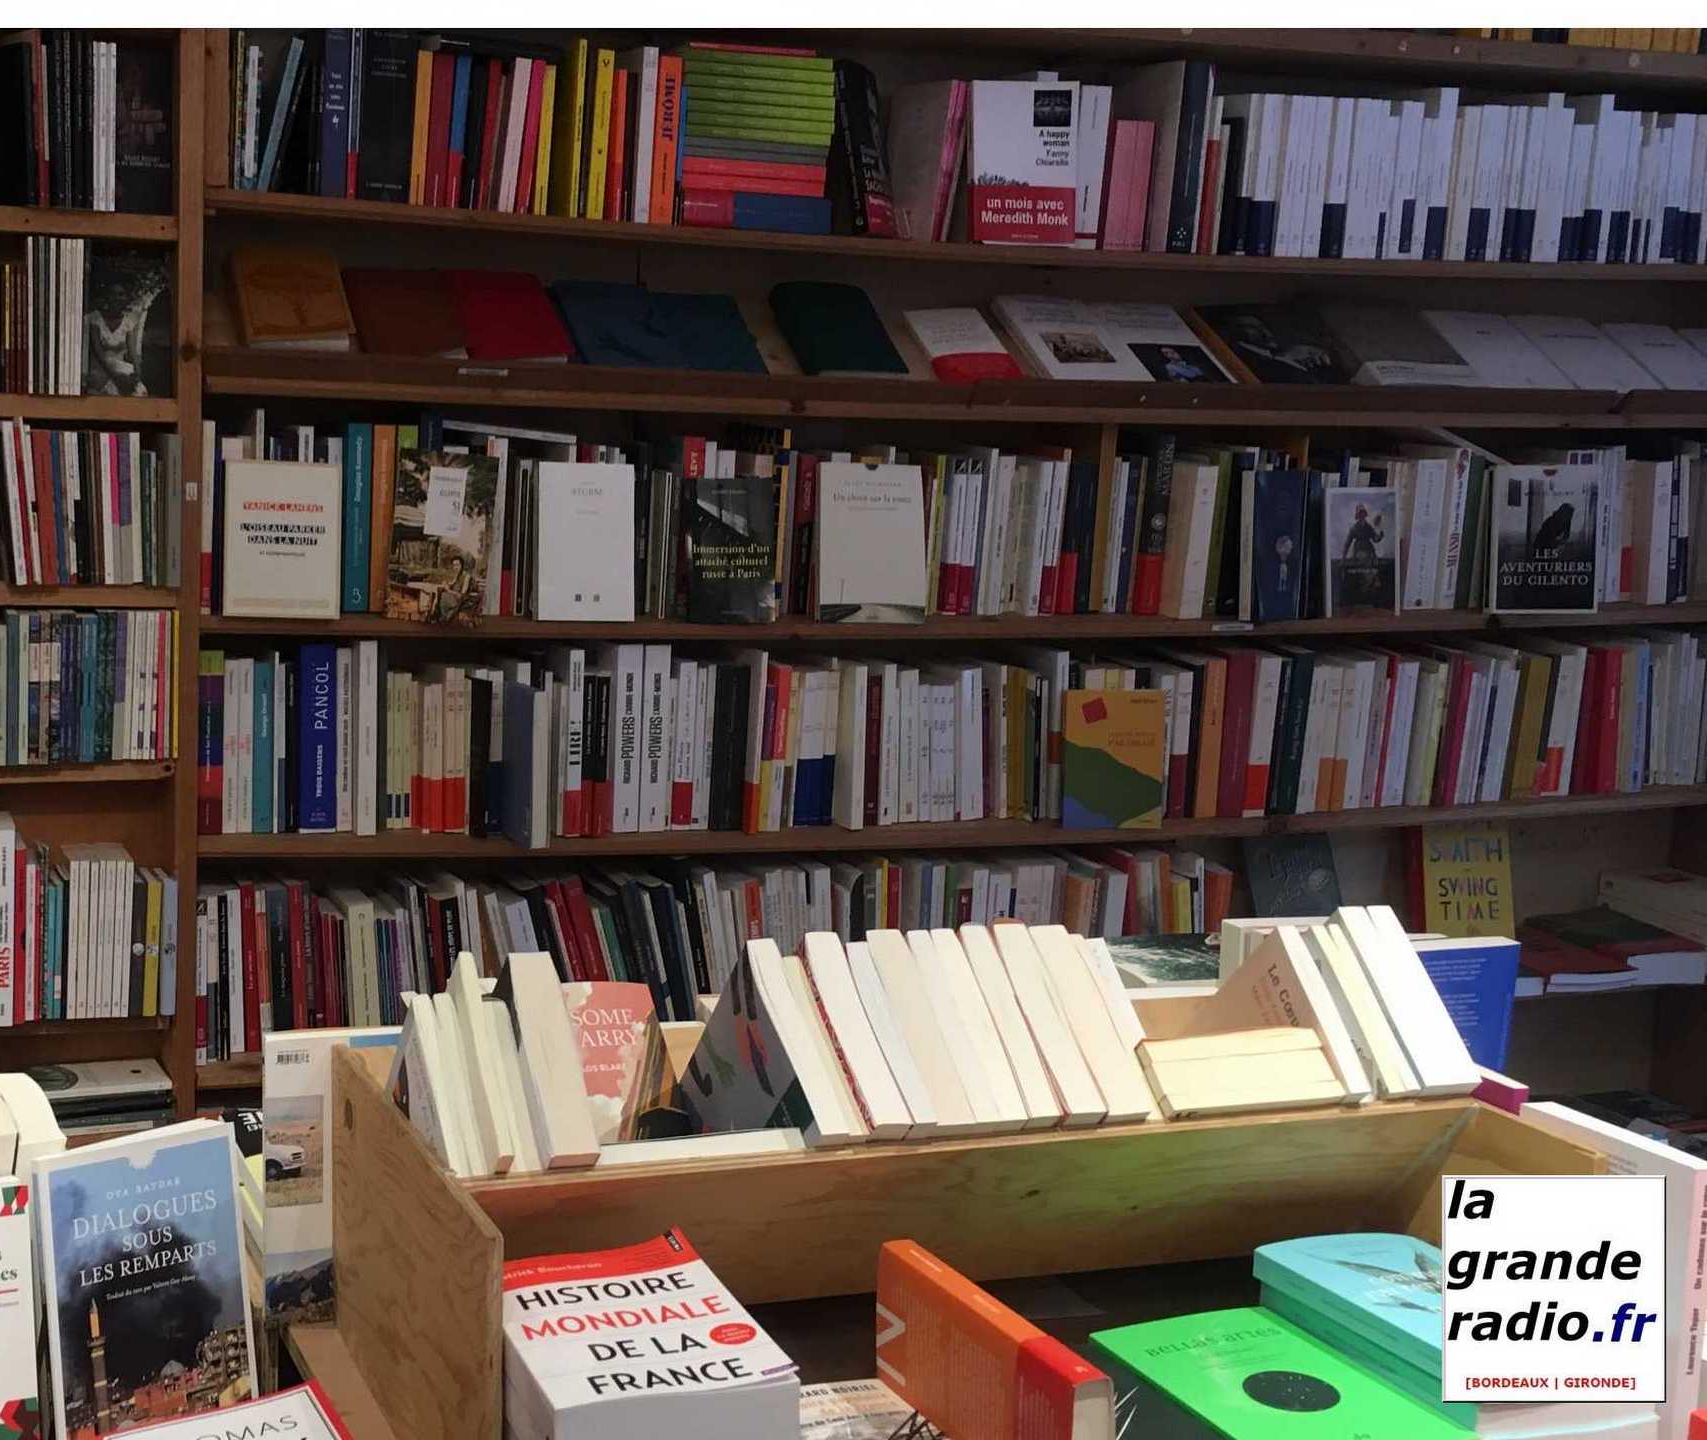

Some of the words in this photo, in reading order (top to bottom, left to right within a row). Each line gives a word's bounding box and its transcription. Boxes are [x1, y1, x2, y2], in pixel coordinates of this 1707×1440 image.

[987, 199, 1001, 208] un
[1005, 197, 1033, 209] mois
[1036, 200, 1064, 210] avec
[981, 211, 1033, 225] Meredith
[1037, 213, 1068, 226] Monk
[693, 544, 745, 554] Immersion
[1535, 548, 1559, 559] LES
[738, 568, 761, 578] Paris
[1500, 561, 1593, 573] AVENTURIERS
[1503, 575, 1523, 585] DU
[1527, 574, 1589, 585] CILENTO
[314, 661, 329, 731] PANCOL
[621, 716, 635, 759] POWERS
[648, 716, 662, 759] POWERS
[1438, 877, 1498, 897] SWING
[1440, 901, 1499, 920] TIME
[72, 1189, 217, 1241] DIALOGUES
[121, 1226, 173, 1253] SOUS
[79, 1266, 115, 1288] LES
[120, 1240, 217, 1276] REMPARTS
[515, 1271, 695, 1311] HISTOIRE
[521, 1295, 731, 1342] MONDIALE
[588, 1339, 635, 1362] DE
[650, 1331, 707, 1355] LA
[586, 1357, 754, 1395] FRANCE
